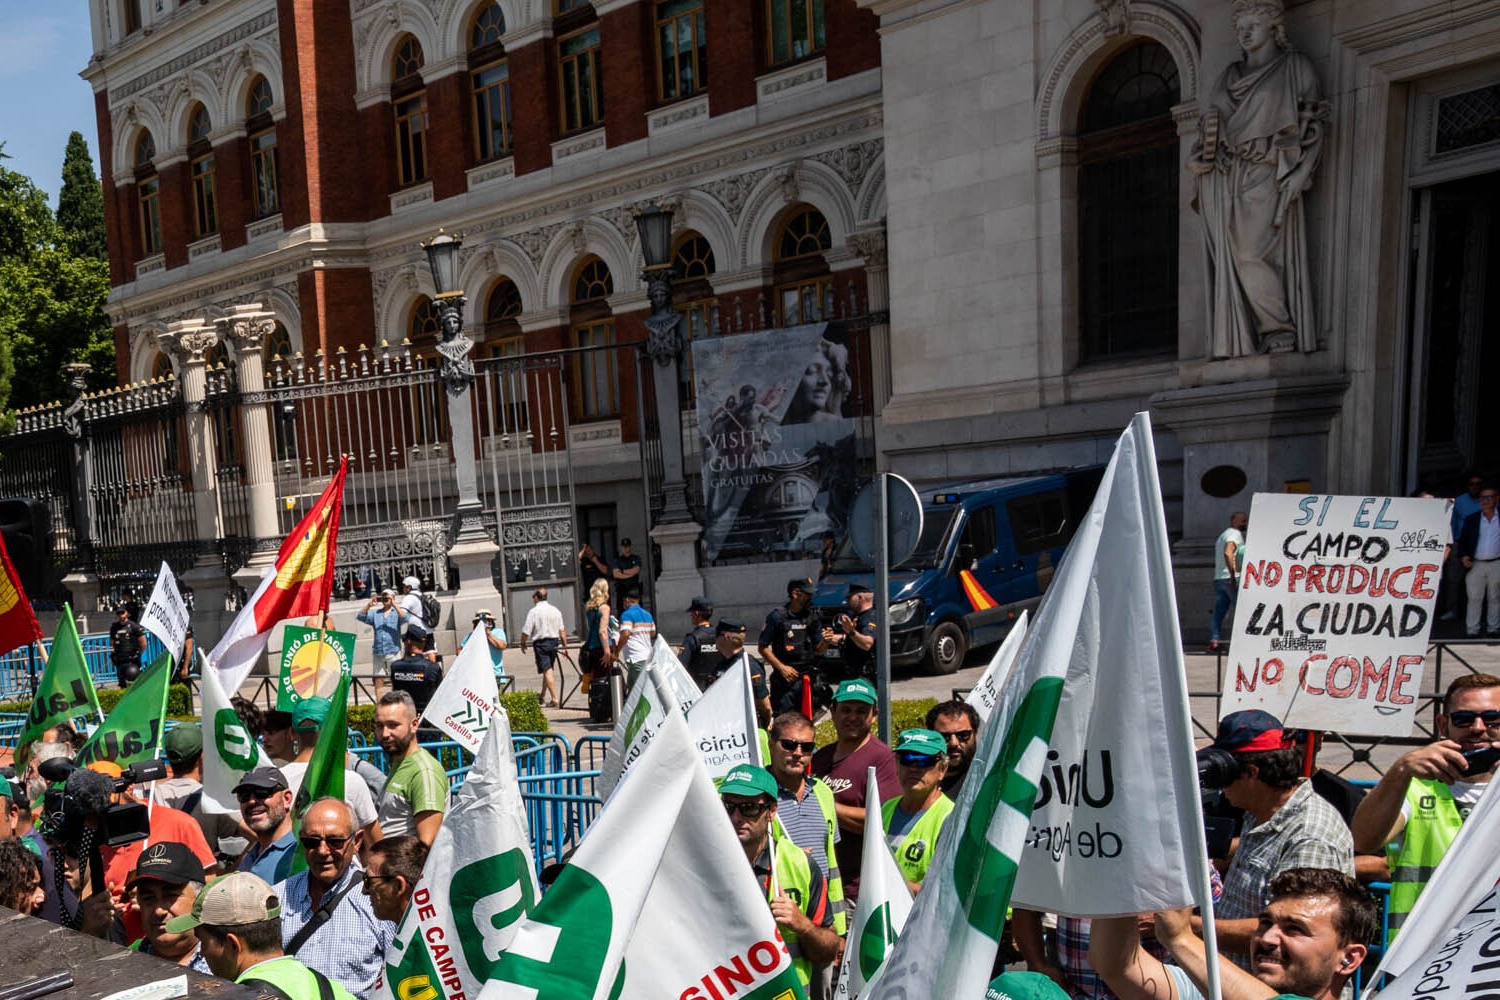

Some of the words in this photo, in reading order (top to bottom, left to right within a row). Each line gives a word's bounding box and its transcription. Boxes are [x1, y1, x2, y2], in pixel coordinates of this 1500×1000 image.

[705, 429, 783, 450] VISITAS
[708, 447, 807, 474] GUIADAS
[710, 473, 775, 489] GRATUITAS
[1293, 496, 1333, 527] SI
[1353, 497, 1399, 530] EL
[1282, 530, 1391, 564] CAMPO
[1243, 559, 1282, 589] NO
[1288, 562, 1440, 600] PRODUCE
[1245, 602, 1284, 636] LA
[1293, 602, 1428, 639] CIUDAD
[284, 639, 302, 668] UNIÓ
[303, 631, 318, 642] DE
[283, 676, 294, 693] DE
[1299, 653, 1426, 705] COME
[461, 688, 490, 712] UNION
[444, 716, 472, 740] Castilla
[472, 738, 480, 746] y
[414, 888, 437, 922] DE
